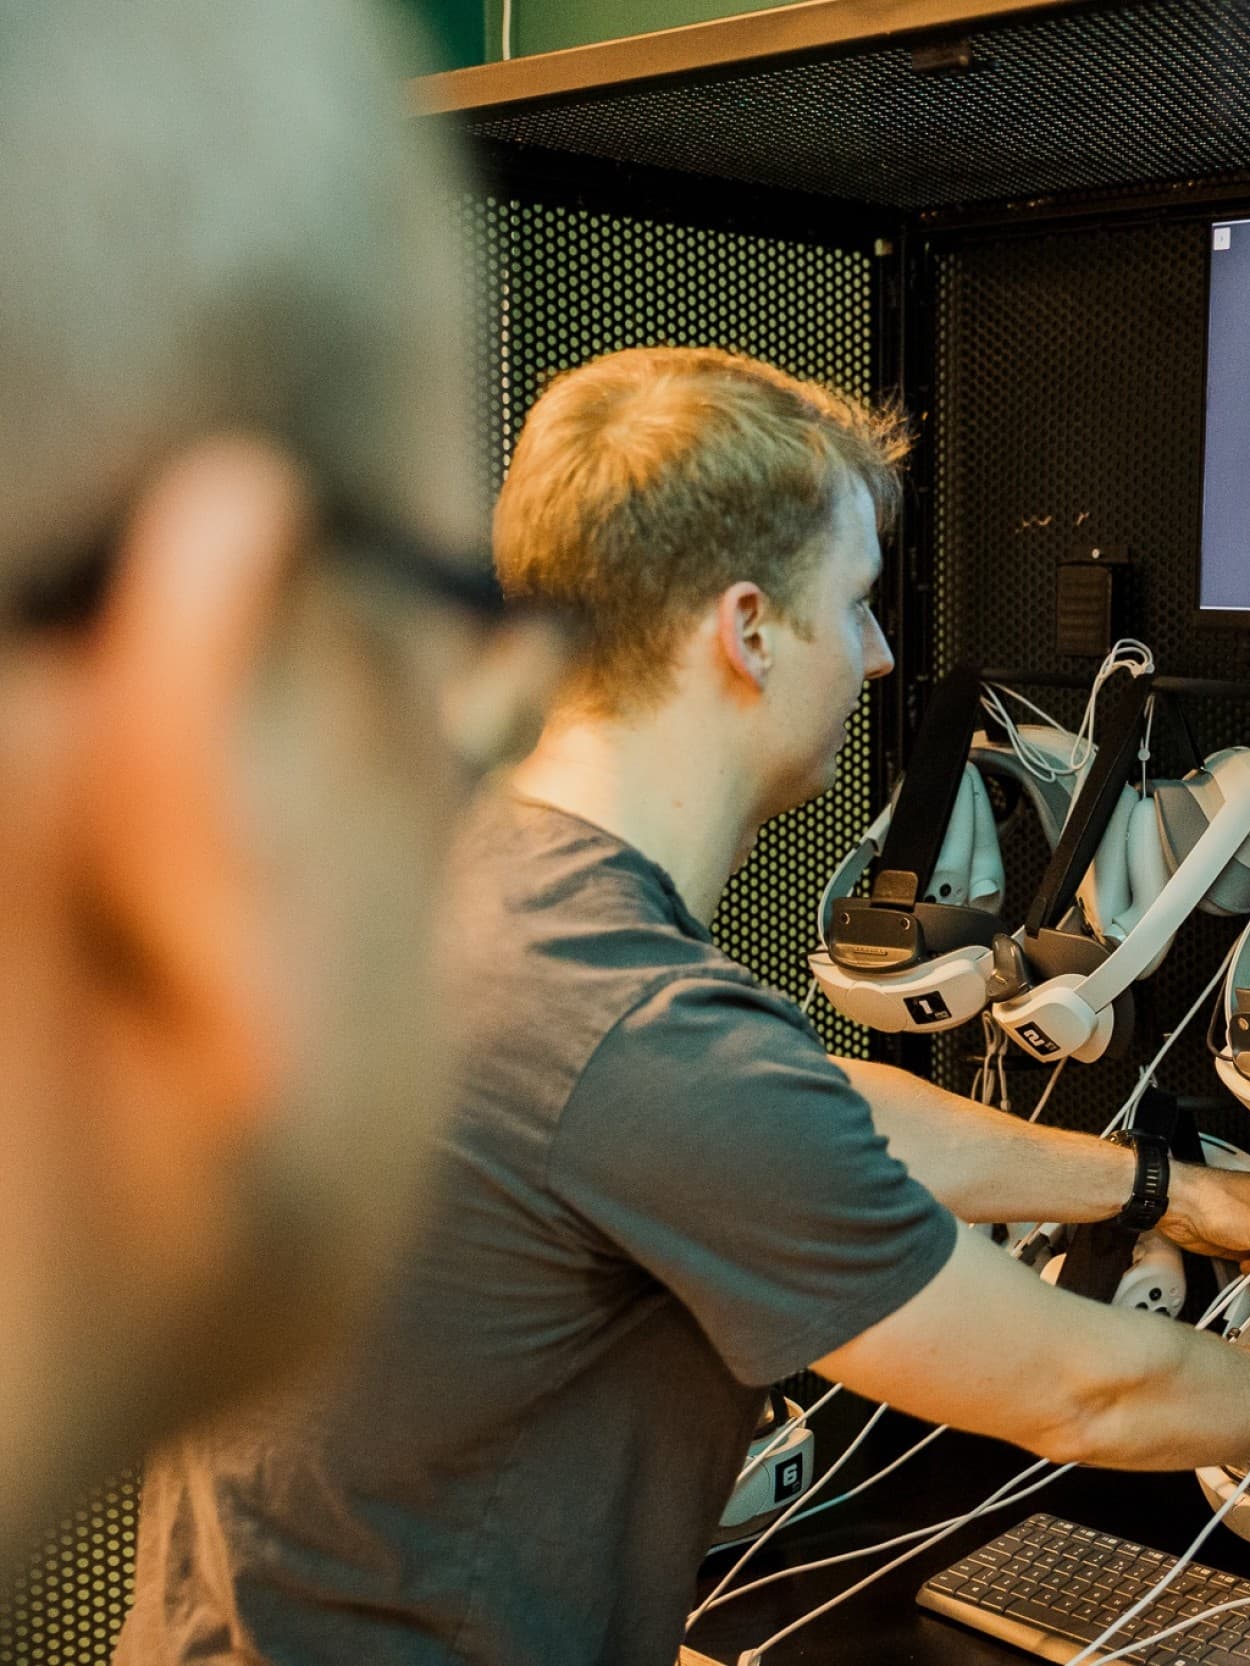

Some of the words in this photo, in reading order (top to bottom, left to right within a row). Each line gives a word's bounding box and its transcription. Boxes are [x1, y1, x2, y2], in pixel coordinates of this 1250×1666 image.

[918, 999, 933, 1015] 1
[1023, 1029, 1046, 1047] 2
[783, 1463, 798, 1487] 6
